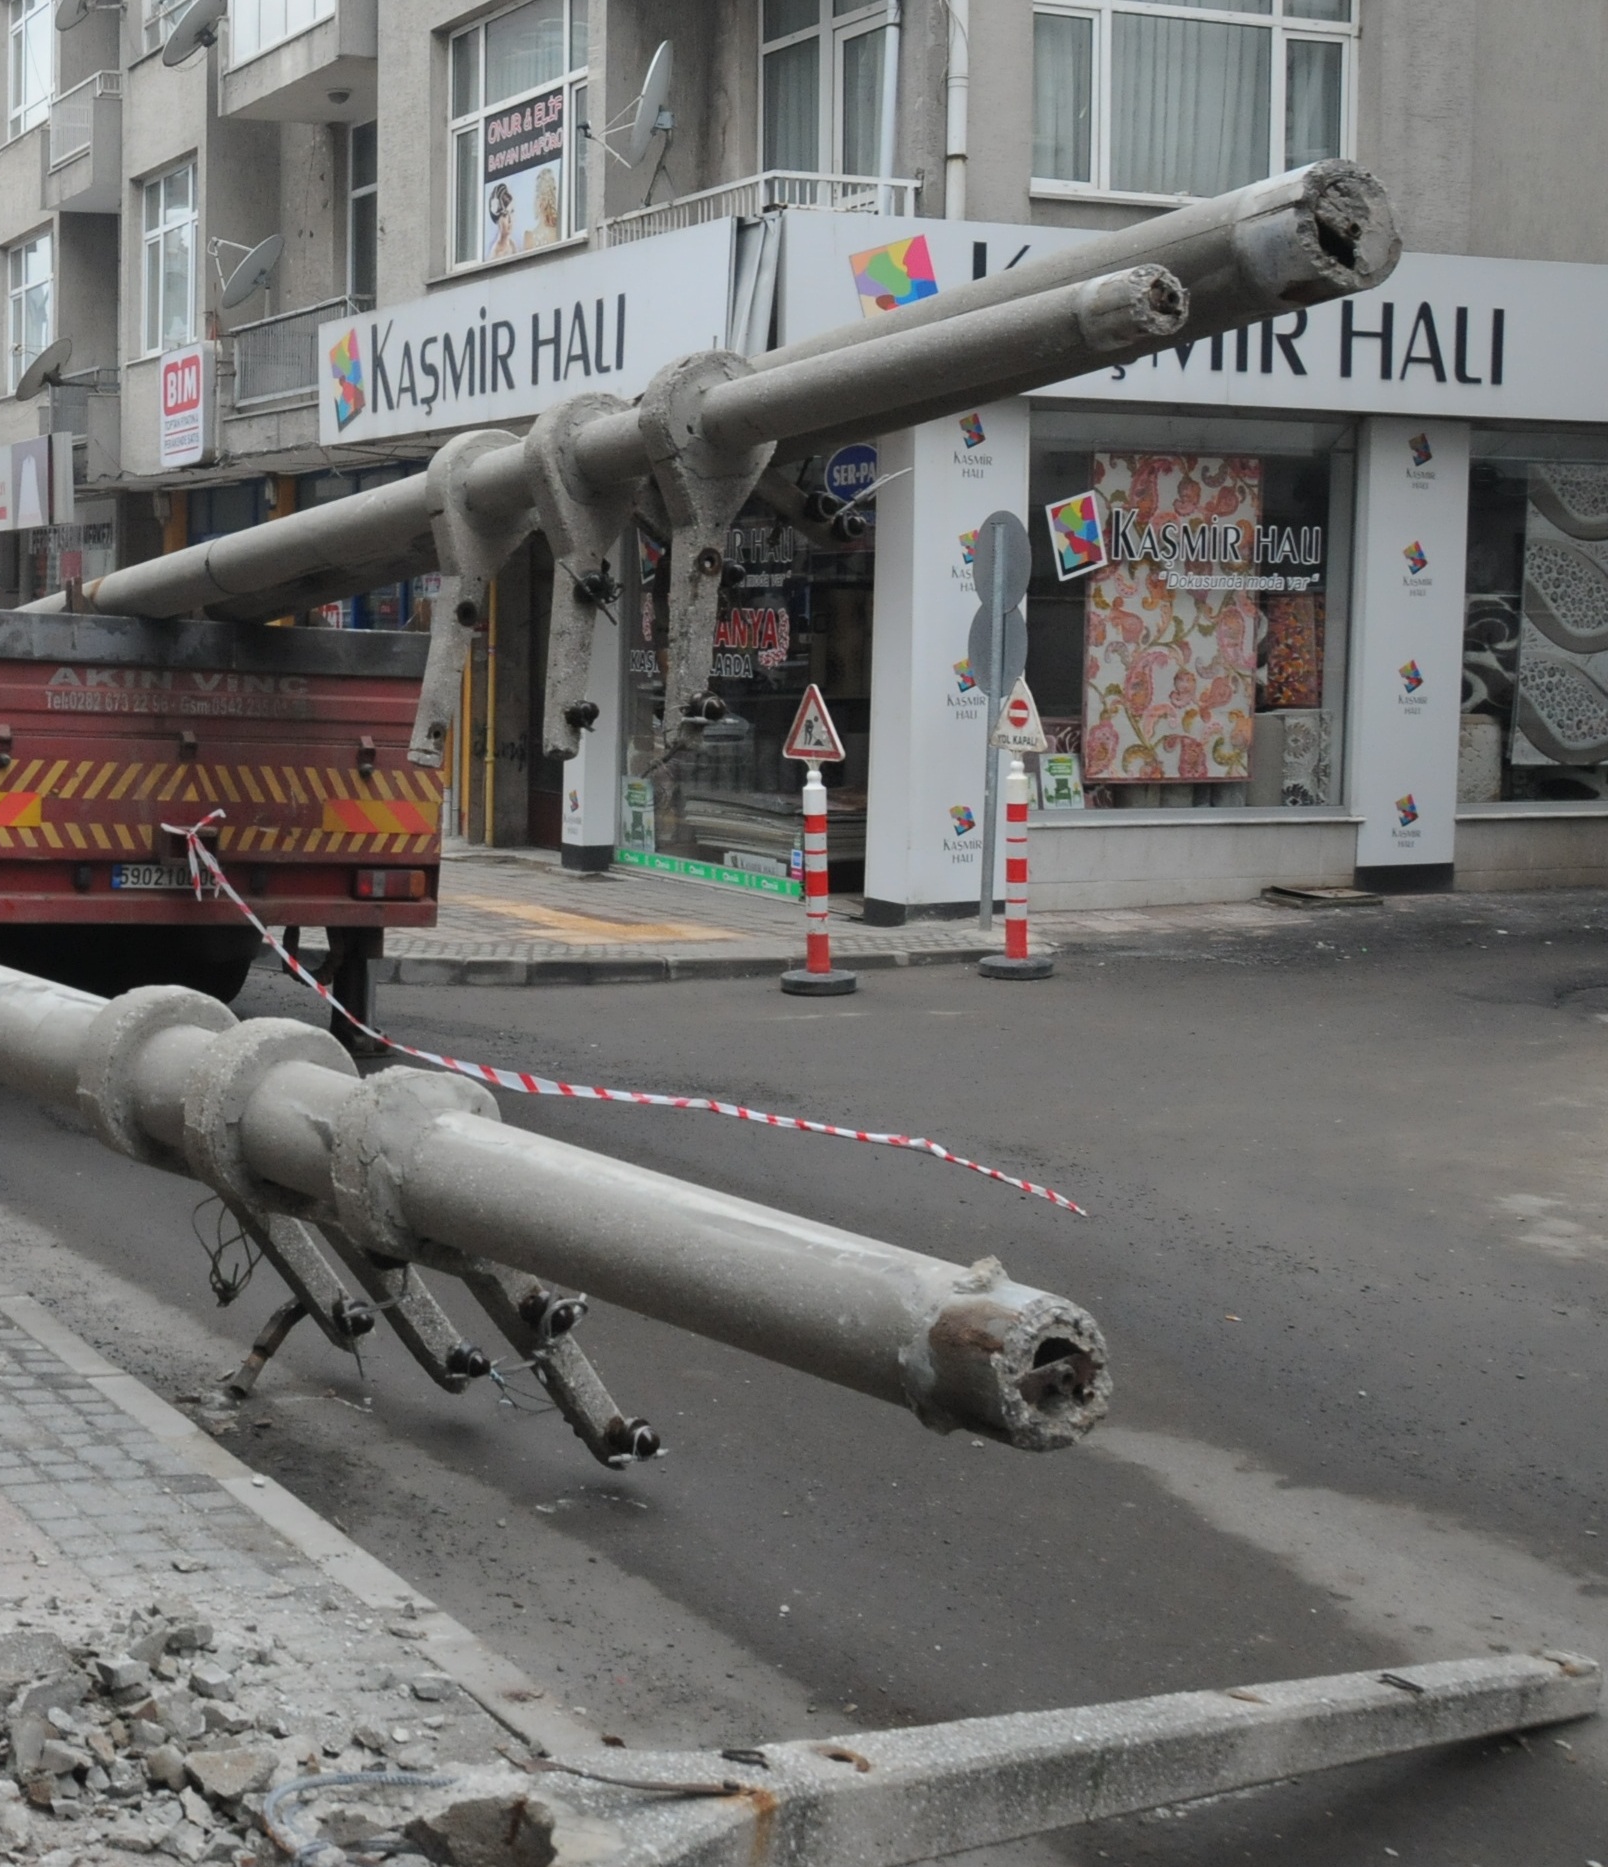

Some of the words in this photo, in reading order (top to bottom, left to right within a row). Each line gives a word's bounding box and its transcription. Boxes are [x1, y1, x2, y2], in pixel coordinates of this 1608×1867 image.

[488, 112, 522, 144] ONUR
[534, 95, 563, 128] ELİF
[488, 146, 519, 172] BAYAN
[371, 305, 516, 415] KAŞMİR
[531, 293, 626, 386] HALI
[1339, 300, 1505, 385] HALI
[962, 468, 984, 478] HALI
[1111, 507, 1242, 569] KAŞMİR
[1253, 525, 1322, 565] HALI
[1245, 574, 1285, 591] moda
[48, 667, 173, 690] AKIN
[956, 710, 977, 720] HALI
[952, 854, 974, 864] HALI
